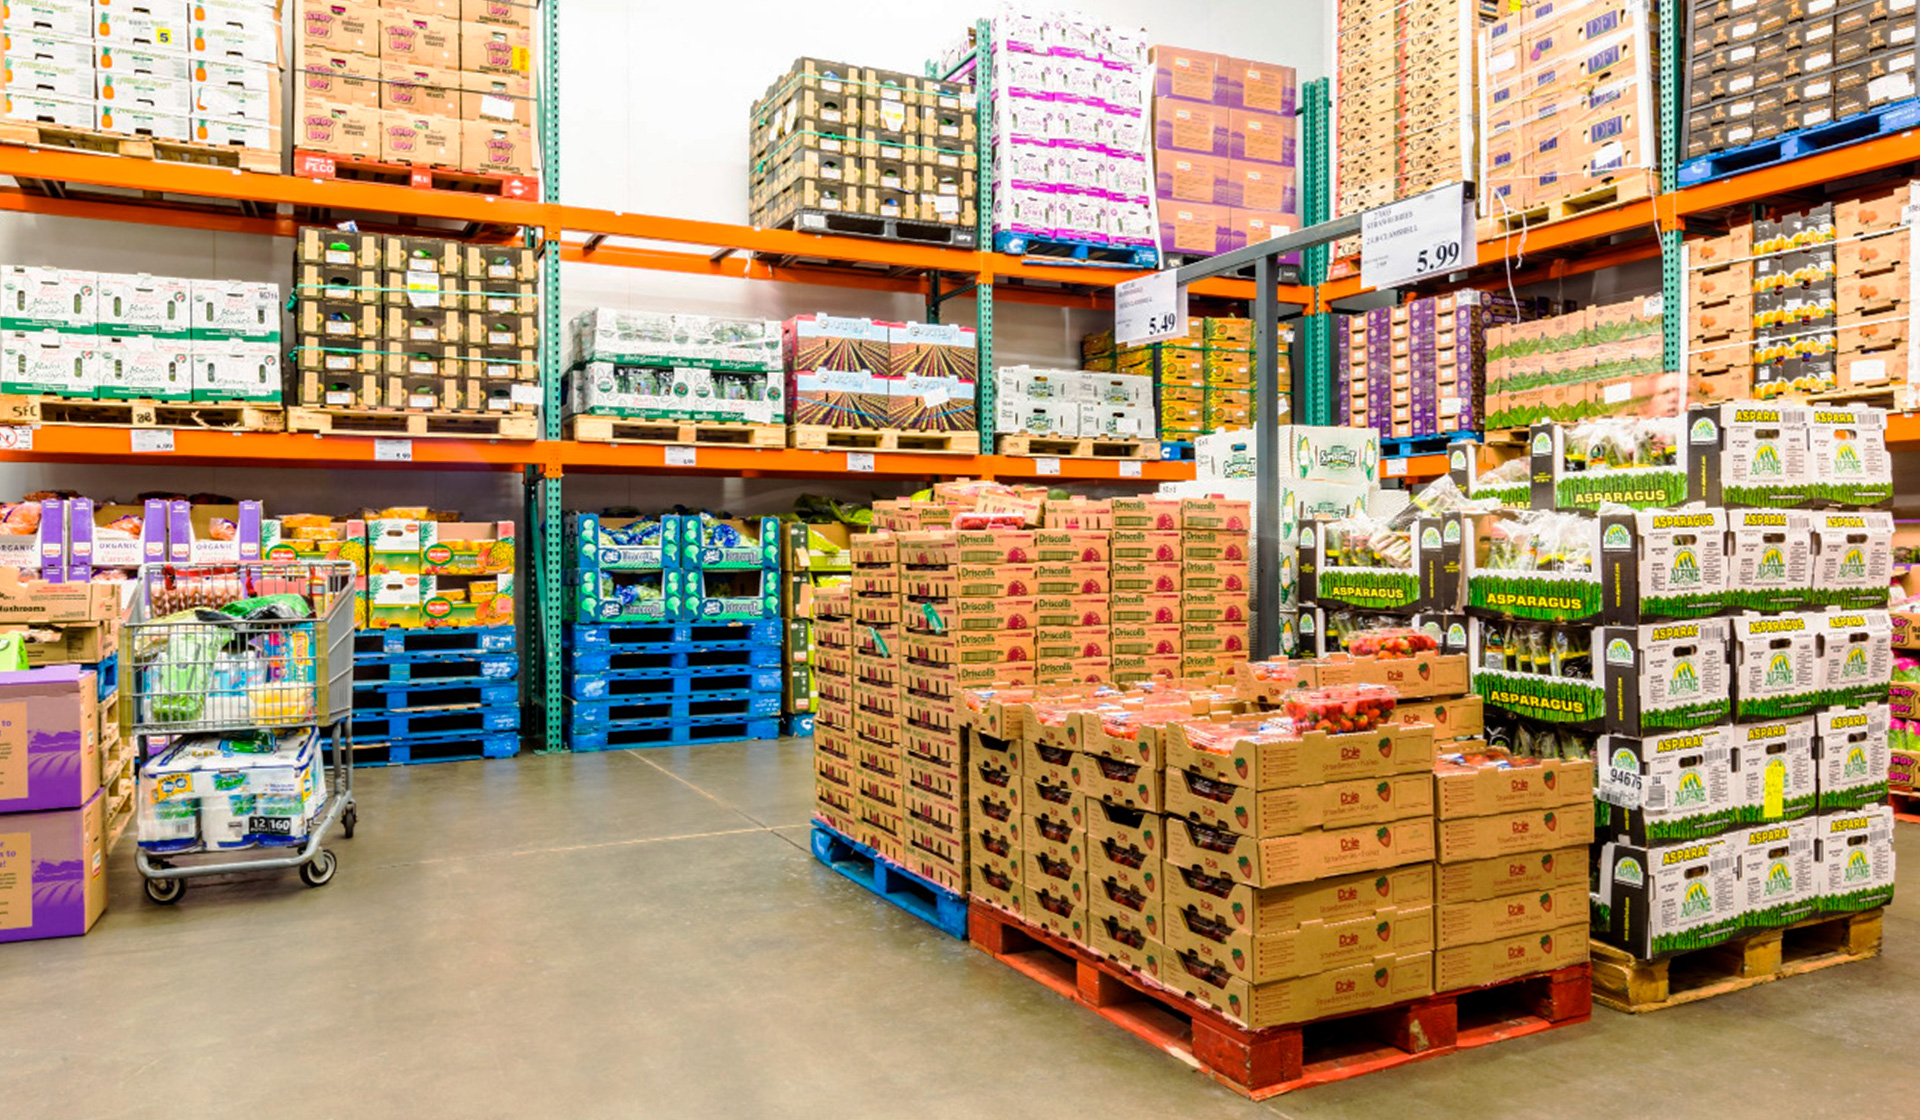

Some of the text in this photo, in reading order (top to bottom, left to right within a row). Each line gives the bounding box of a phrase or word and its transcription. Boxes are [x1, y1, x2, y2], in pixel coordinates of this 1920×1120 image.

[159, 32, 169, 43] 5
[1417, 241, 1459, 273] 5.99
[1149, 312, 1175, 335] 5.49
[1575, 489, 1666, 504] ASPARAGUS
[1653, 513, 1715, 529] ASPARAGUS
[99, 541, 138, 550] ORGANIC
[196, 542, 234, 551] ORGANIC
[1332, 587, 1404, 600] ASPARAGUS
[1487, 593, 1582, 611] ASPARAGUS
[1749, 618, 1805, 634] ASPARAGUS
[1387, 670, 1403, 681] Dole
[1667, 677, 1699, 696] ALPINE
[1490, 690, 1585, 714] ASPARAGUS
[1404, 713, 1420, 724] Dole
[1341, 747, 1360, 761] Dole
[1511, 779, 1528, 792] Dole
[1610, 768, 1642, 790] 94676
[1340, 791, 1360, 805] Dole
[252, 819, 290, 830] 12 160
[1512, 821, 1529, 833] Dole
[1340, 837, 1359, 851] Dole
[1509, 864, 1526, 876] Dole
[1337, 887, 1358, 900] Dole
[1508, 904, 1525, 916] Dole
[1338, 933, 1359, 947] Dole
[1508, 946, 1525, 958] Dole
[1335, 980, 1355, 994] Dole
